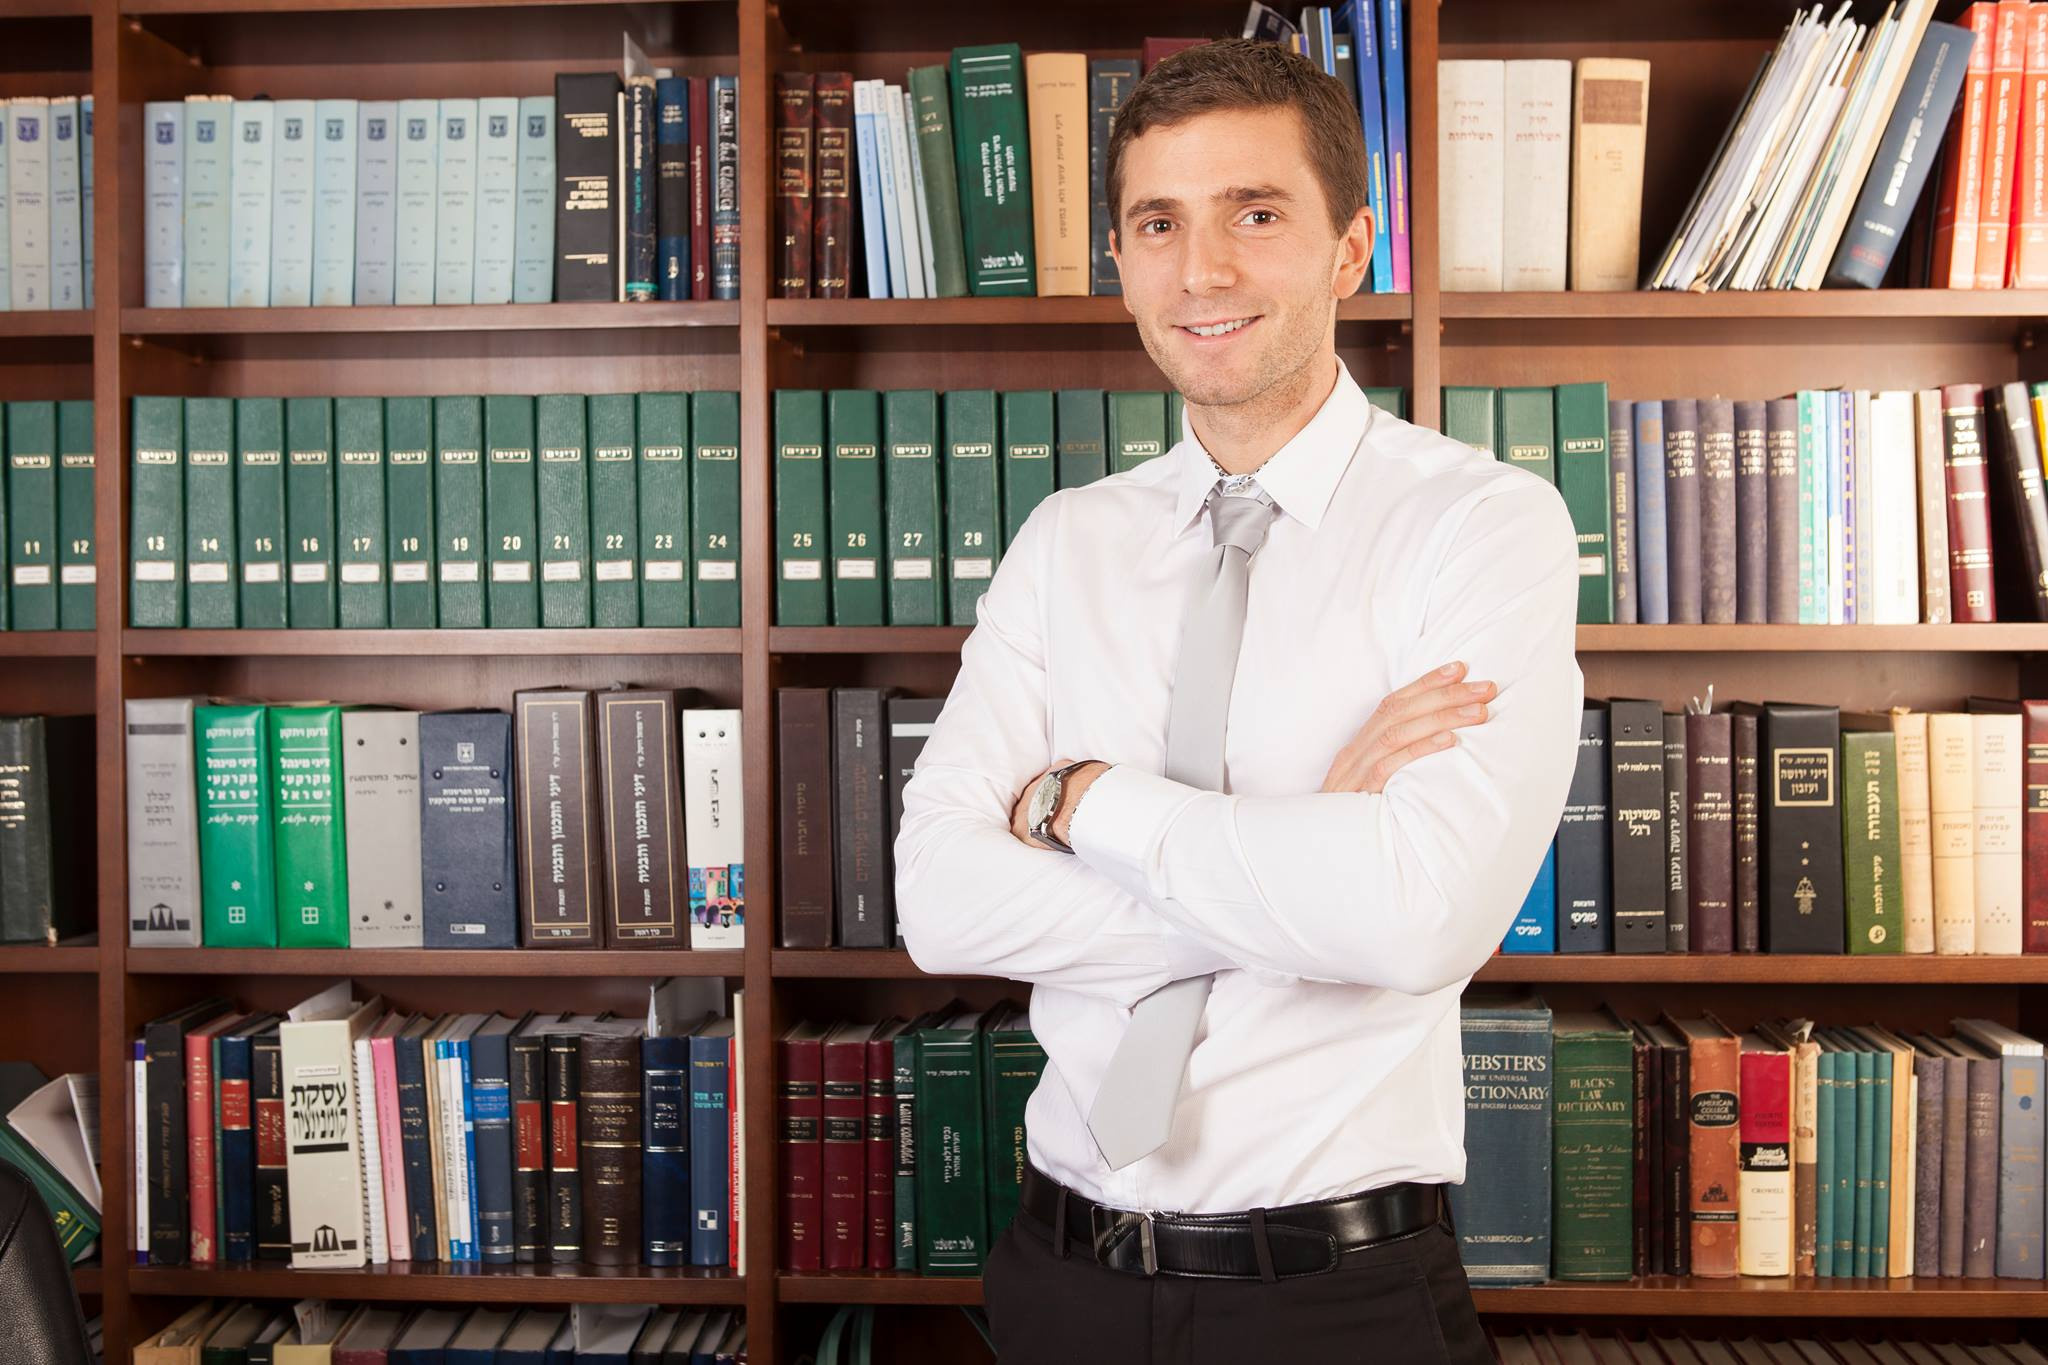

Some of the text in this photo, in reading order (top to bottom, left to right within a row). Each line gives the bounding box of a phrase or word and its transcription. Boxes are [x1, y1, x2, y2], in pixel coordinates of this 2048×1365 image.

[147, 537, 165, 551] 13
[201, 538, 218, 552] 14
[255, 538, 272, 552] 15
[302, 538, 318, 552] 16
[353, 538, 371, 552] 17
[402, 538, 418, 552] 18
[452, 538, 469, 551] 19
[503, 536, 521, 550] 20
[554, 535, 570, 550] 21
[606, 535, 623, 549] 22
[655, 535, 672, 549] 23
[709, 535, 727, 549] 24
[793, 533, 812, 548] 25
[848, 533, 866, 547] 26
[904, 533, 922, 547] 27
[964, 532, 983, 546] 28
[24, 541, 40, 554] 11
[73, 540, 89, 554] 12
[207, 758, 257, 768] דיני מינהל
[281, 758, 331, 768] דיני מינהל
[1630, 762, 1650, 772] שלמה
[207, 774, 258, 786] מקרקעי
[281, 774, 331, 786] מקרקעי
[1781, 769, 1827, 780] דיני ירושה
[207, 788, 258, 800] ישראל
[281, 788, 331, 800] ישראל
[1791, 782, 1818, 796] ועזבון
[1867, 781, 1881, 841] תעבורה
[797, 782, 807, 856] מיסוי חברות
[549, 774, 565, 883] דיני התכנון והבניה
[633, 774, 650, 883] דיני התכנון והבניה
[1629, 819, 1651, 836] רגל
[1669, 791, 1683, 890] דיני ירושה ועזבון
[1873, 855, 1884, 915] עיקרי הלכות
[1470, 1074, 1528, 1083] NEW UNIVERSAL
[1570, 1078, 1615, 1089] BLACK'S
[291, 1082, 347, 1108] עסקת
[1463, 1085, 1547, 1101] ICTIONARY
[1580, 1090, 1603, 1099] LAW
[1508, 1103, 1542, 1111] LANGUAGE
[1558, 1102, 1626, 1112] DICTIONARY
[1697, 1099, 1734, 1107] AMERICAN
[1700, 1106, 1729, 1114] COLLEGE
[292, 1107, 348, 1140] קומבינציה
[1694, 1113, 1736, 1121] DICTIONARY
[943, 1126, 952, 1143] נכסי
[1015, 1126, 1024, 1143] נכסי
[952, 1132, 961, 1177] הערות אזהרה
[1474, 1235, 1524, 1244] UNABRIDGED
